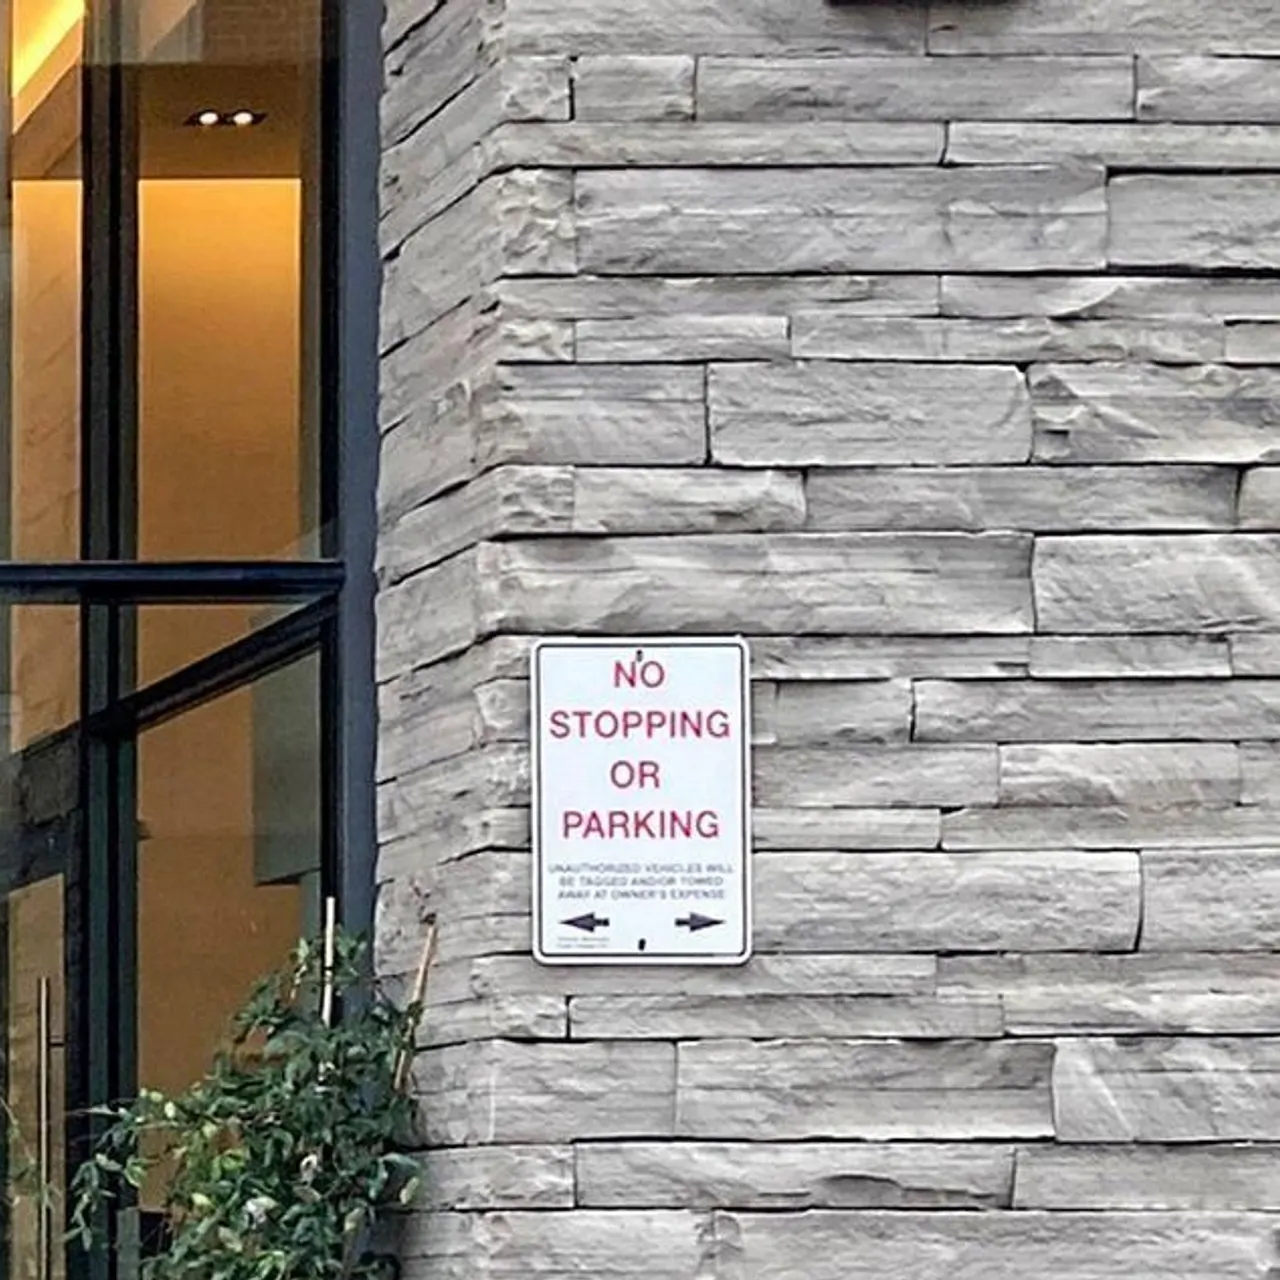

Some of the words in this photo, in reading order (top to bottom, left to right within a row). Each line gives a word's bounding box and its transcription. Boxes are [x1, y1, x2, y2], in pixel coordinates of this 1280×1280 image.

[613, 660, 665, 688] NO
[549, 709, 731, 739] STOPPING
[610, 760, 661, 789] OR
[562, 810, 720, 839] PARKING
[548, 862, 640, 873] UNAUTHORIZED
[645, 863, 701, 873] VEHICLES
[706, 863, 734, 873] WILL
[559, 876, 575, 886] BE
[579, 876, 628, 886] TAGGED
[680, 876, 724, 886] TOWED
[558, 889, 590, 899] AWAY
[594, 889, 608, 899] AT
[670, 889, 725, 899] EXPENSE
